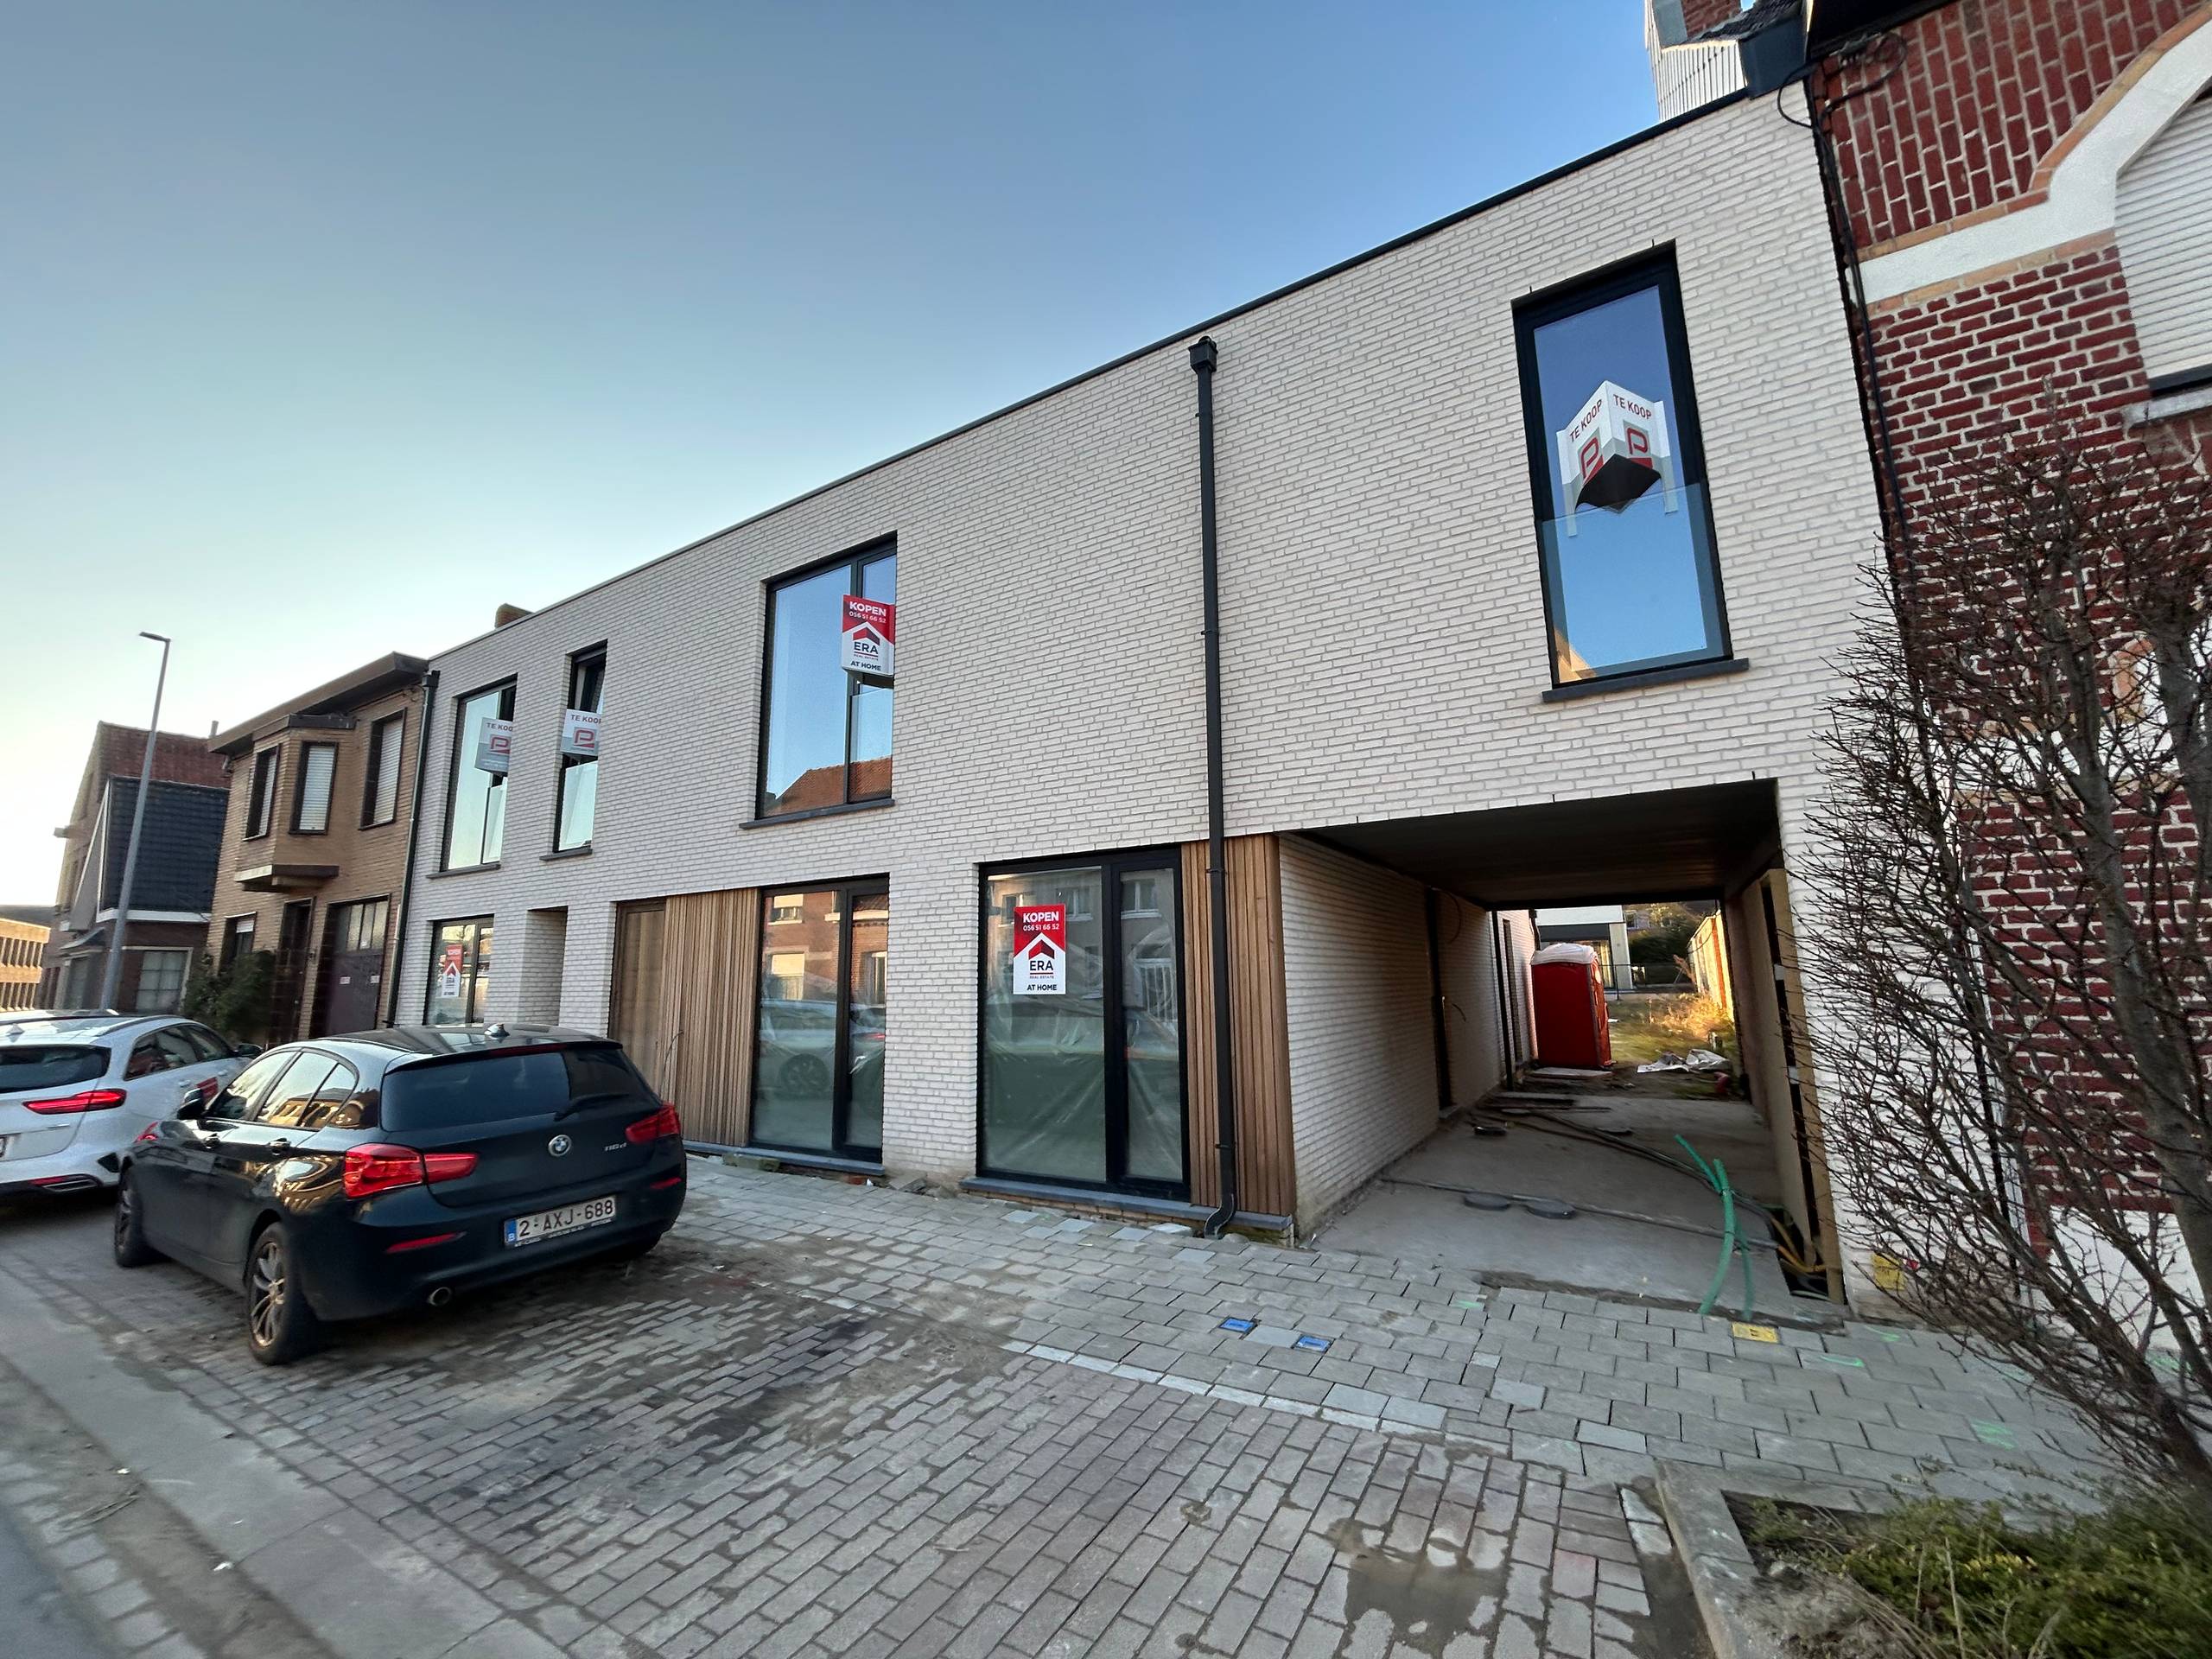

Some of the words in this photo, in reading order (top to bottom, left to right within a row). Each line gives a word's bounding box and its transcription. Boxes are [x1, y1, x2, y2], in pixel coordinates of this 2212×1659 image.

[1613, 394, 1625, 409] TE
[1627, 400, 1651, 420] KOOP
[1569, 423, 1580, 442] TE
[1581, 399, 1603, 431] KOOP
[849, 601, 887, 617] KOPEN
[854, 641, 879, 654] ERA
[861, 662, 881, 671] HOME
[1023, 911, 1059, 923] KOPEN
[1029, 960, 1053, 971] ERA
[519, 1199, 613, 1237] 2-AXJ-688
